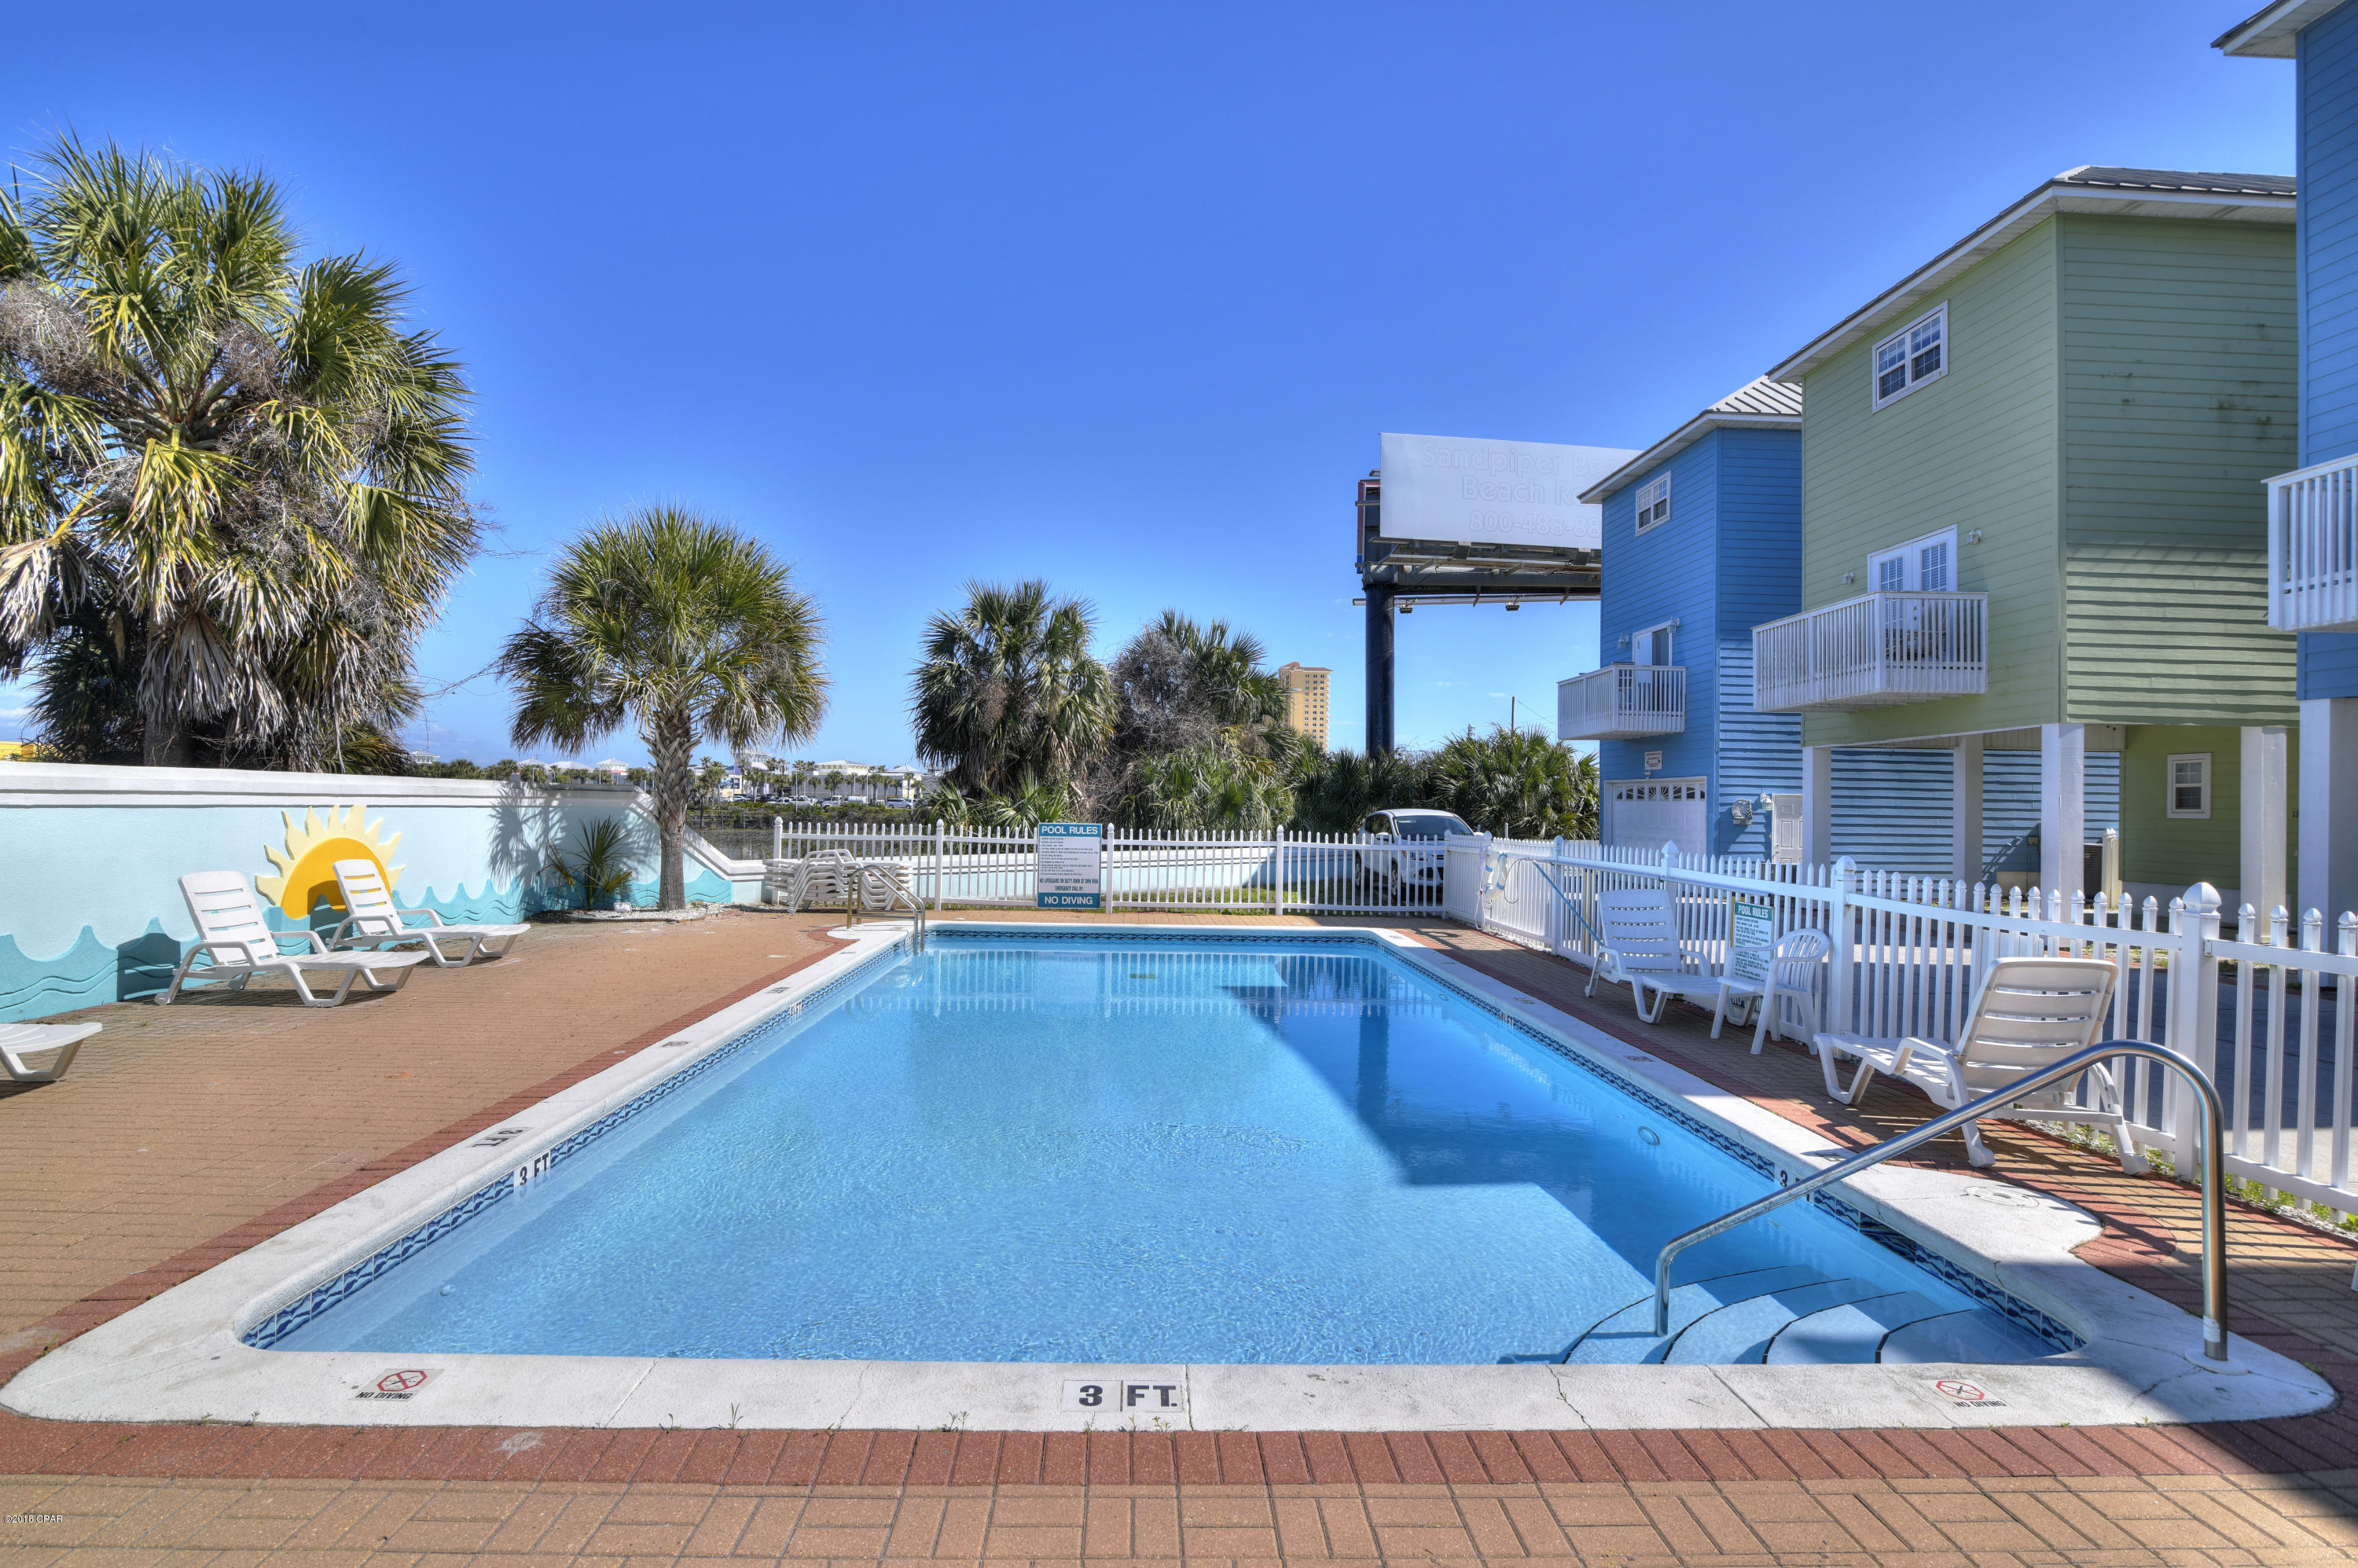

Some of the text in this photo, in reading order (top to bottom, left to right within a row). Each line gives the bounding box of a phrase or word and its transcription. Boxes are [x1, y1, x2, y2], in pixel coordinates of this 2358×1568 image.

[1420, 440, 1564, 479] Sandpiper
[1461, 474, 1546, 504] Beach
[1069, 826, 1098, 835] RULES
[1061, 896, 1093, 905] DIVING
[1738, 905, 1768, 918] POOL RULES
[520, 1166, 527, 1186] 3
[1780, 1170, 1787, 1188] 3
[1078, 1385, 1177, 1407] 3 FT.
